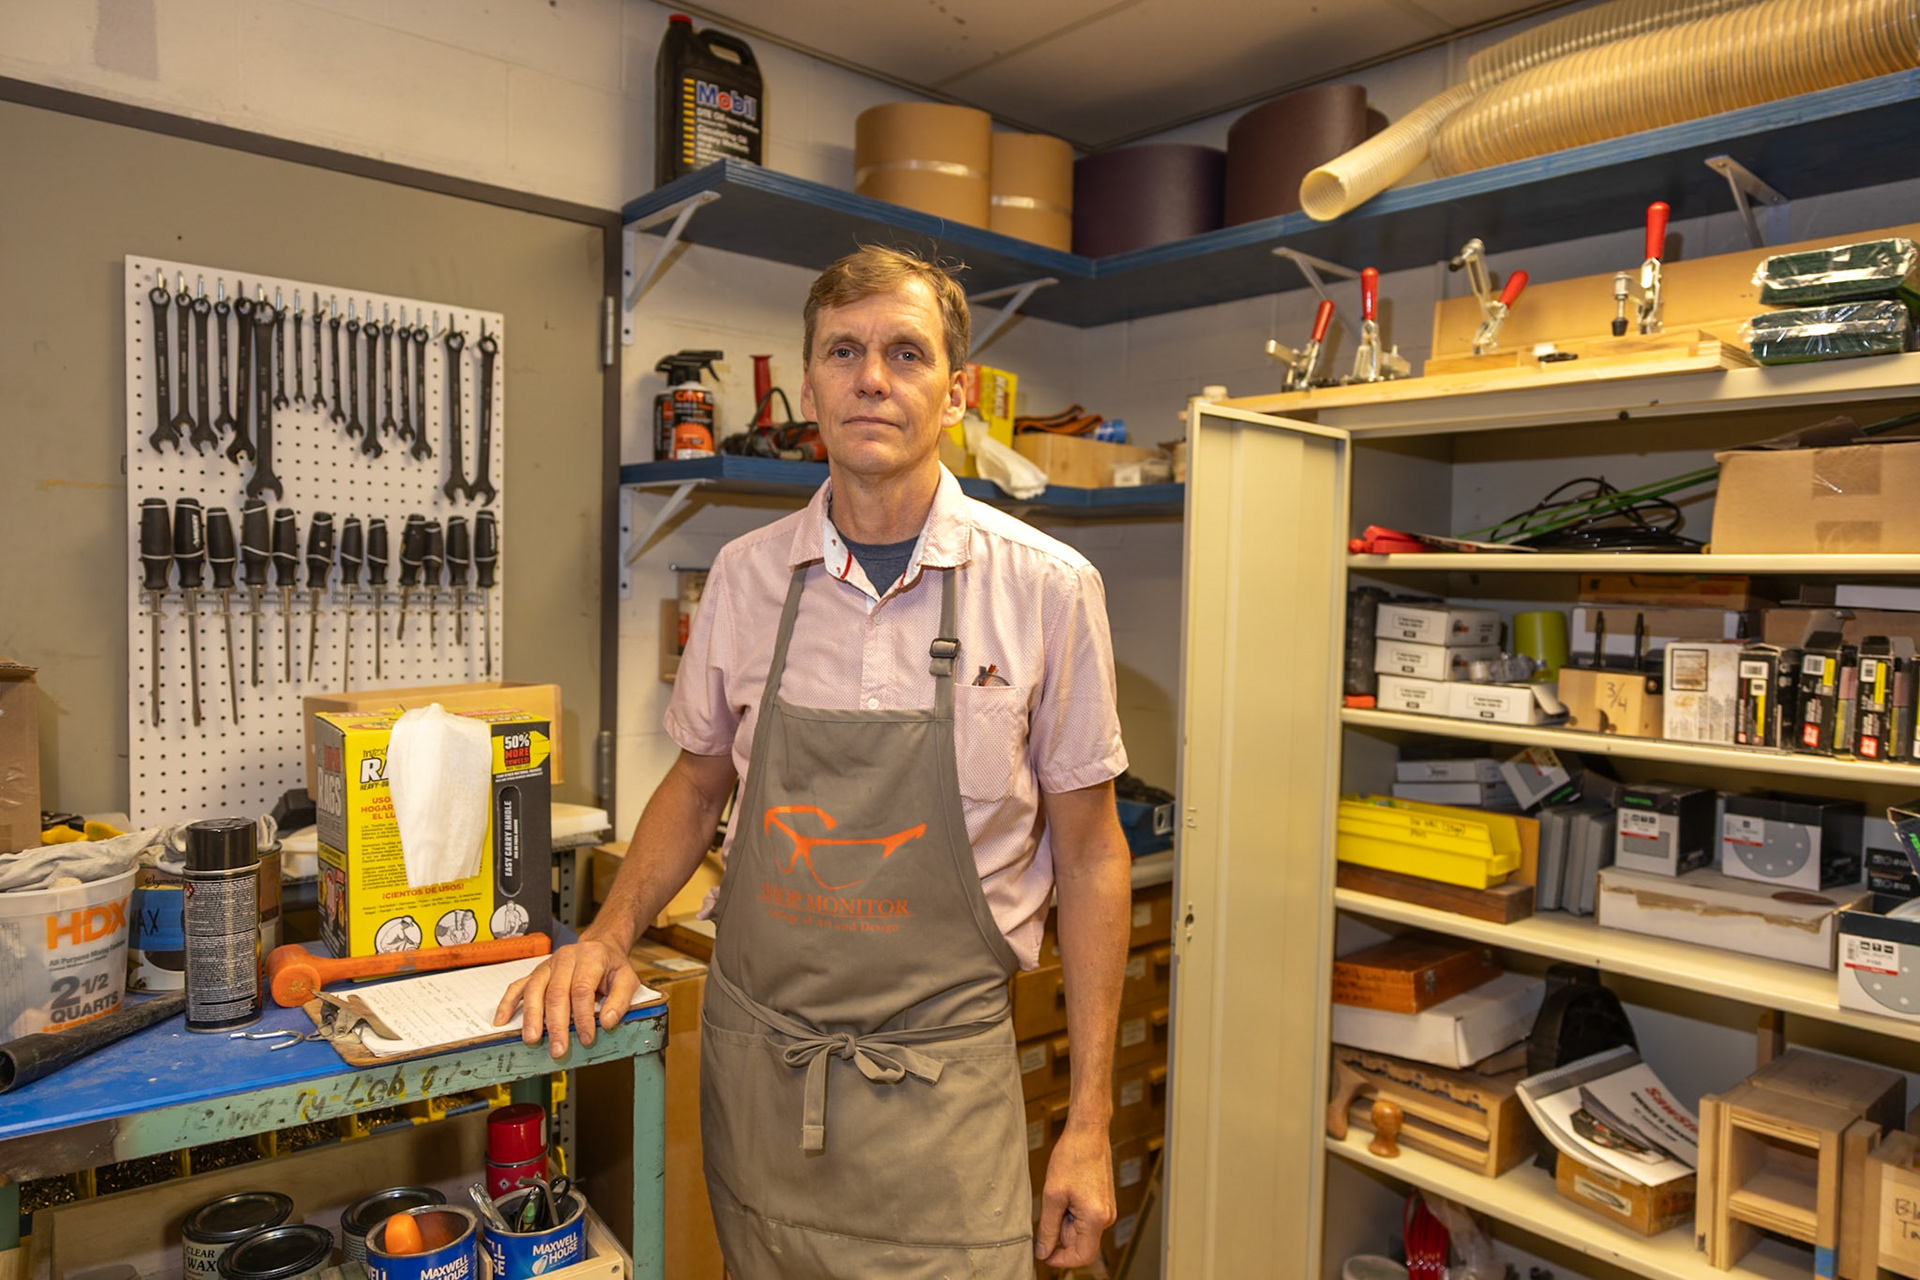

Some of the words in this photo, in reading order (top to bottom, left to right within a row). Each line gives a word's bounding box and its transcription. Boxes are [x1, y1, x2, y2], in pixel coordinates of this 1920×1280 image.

[696, 80, 757, 121] Mobil
[1606, 681, 1628, 712] 3/4
[505, 733, 530, 750] 50%
[505, 747, 529, 759] MORE
[317, 765, 341, 818] RAGS
[361, 804, 393, 813] HOGAR
[503, 800, 512, 830] HANDLE
[504, 831, 513, 857] CARRY
[504, 857, 513, 877] EASY
[425, 886, 437, 894] DE
[439, 883, 464, 892] USOS!
[761, 882, 802, 909] SHOP
[807, 893, 910, 917] MONITOR
[46, 896, 129, 950] HDX
[766, 907, 799, 925] College
[803, 916, 813, 924] of
[817, 917, 832, 928] Art
[835, 921, 857, 932] and
[860, 921, 899, 934] Design
[49, 958, 60, 967] All
[61, 953, 90, 965] Purpose
[50, 975, 81, 1011] 2
[82, 973, 110, 995] 1/2
[50, 990, 119, 1024] QUARTS
[186, 1245, 215, 1258] CLEAR
[533, 1231, 579, 1257] MAXWELL
[548, 1240, 578, 1265] HOUSE
[187, 1256, 218, 1273] WAX
[420, 1254, 469, 1280] MAXWELL
